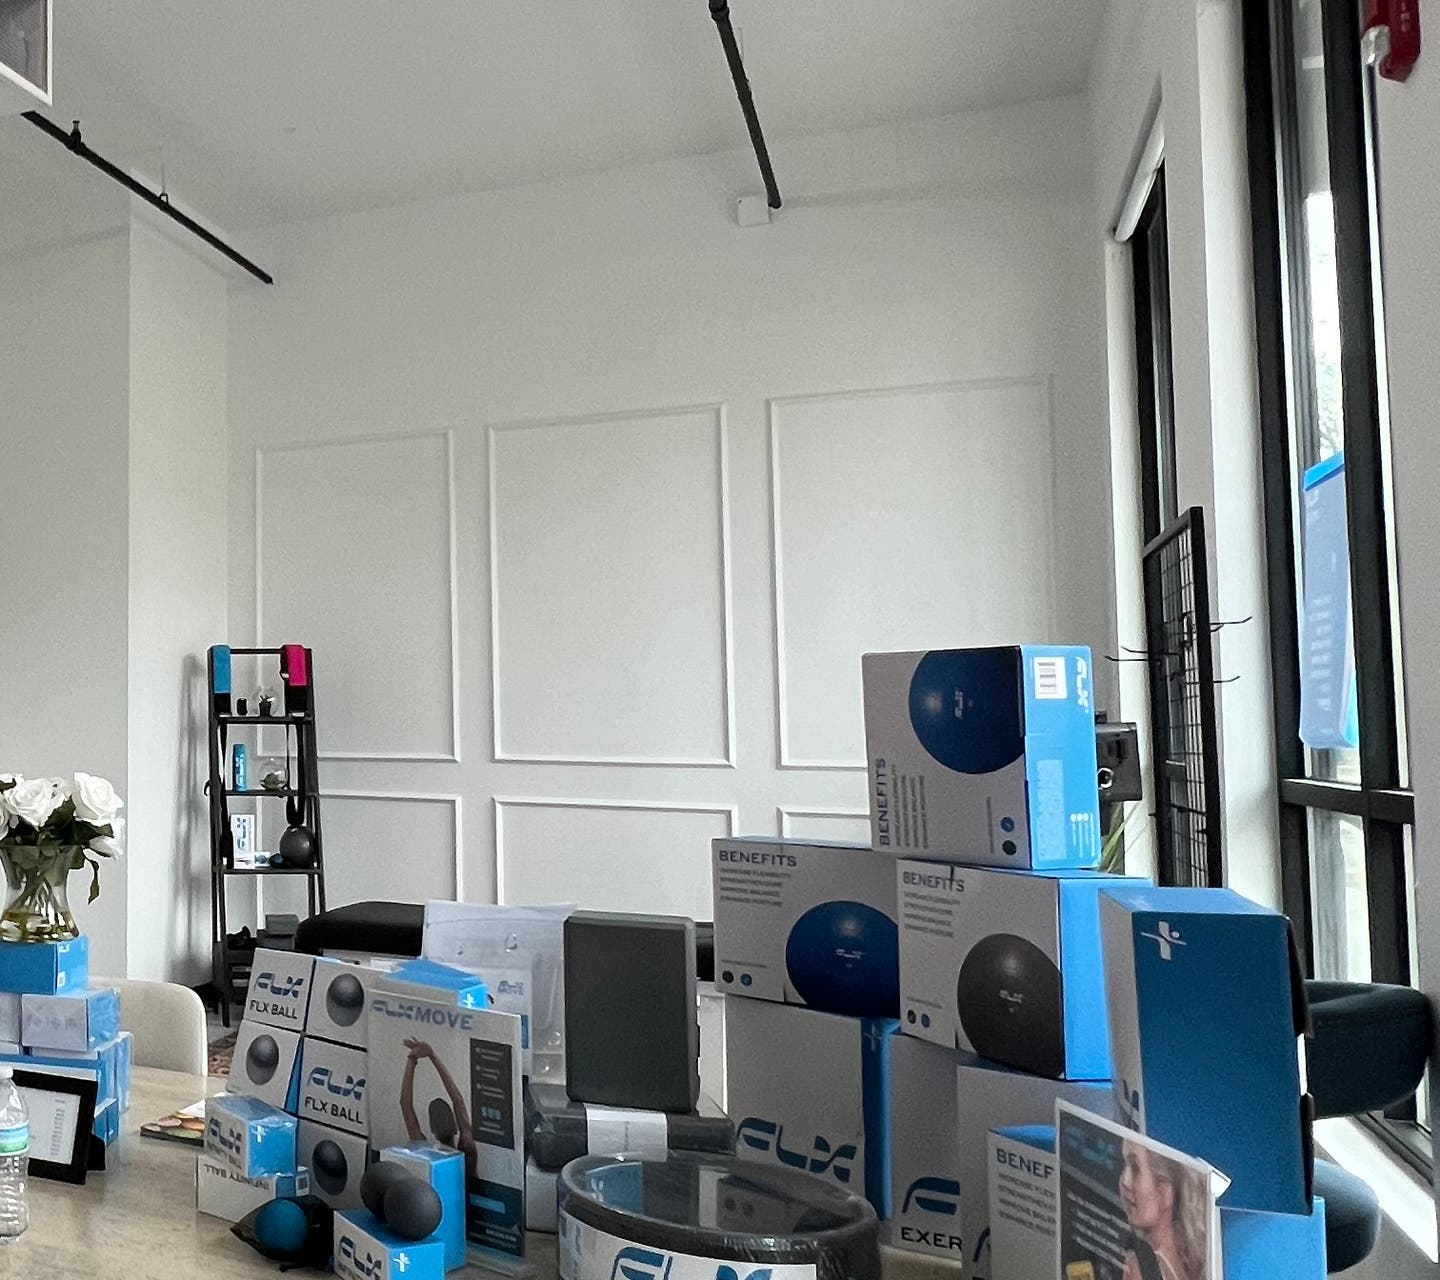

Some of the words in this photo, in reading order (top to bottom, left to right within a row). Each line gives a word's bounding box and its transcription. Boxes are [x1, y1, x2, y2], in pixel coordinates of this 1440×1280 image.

[876, 758, 890, 846] BENEFITS
[719, 850, 797, 867] BENEFITS
[903, 871, 965, 893] BENEFITS
[254, 972, 304, 999] FLX
[249, 999, 271, 1013] FLX
[271, 1004, 298, 1020] BALL
[307, 1067, 366, 1101] FLX
[304, 1096, 329, 1114] FLX
[330, 1104, 364, 1125] BALL
[737, 1117, 857, 1184] FLX
[204, 1163, 227, 1179] BALL
[996, 1148, 1054, 1181] BENEF
[901, 1226, 962, 1252] EXER
